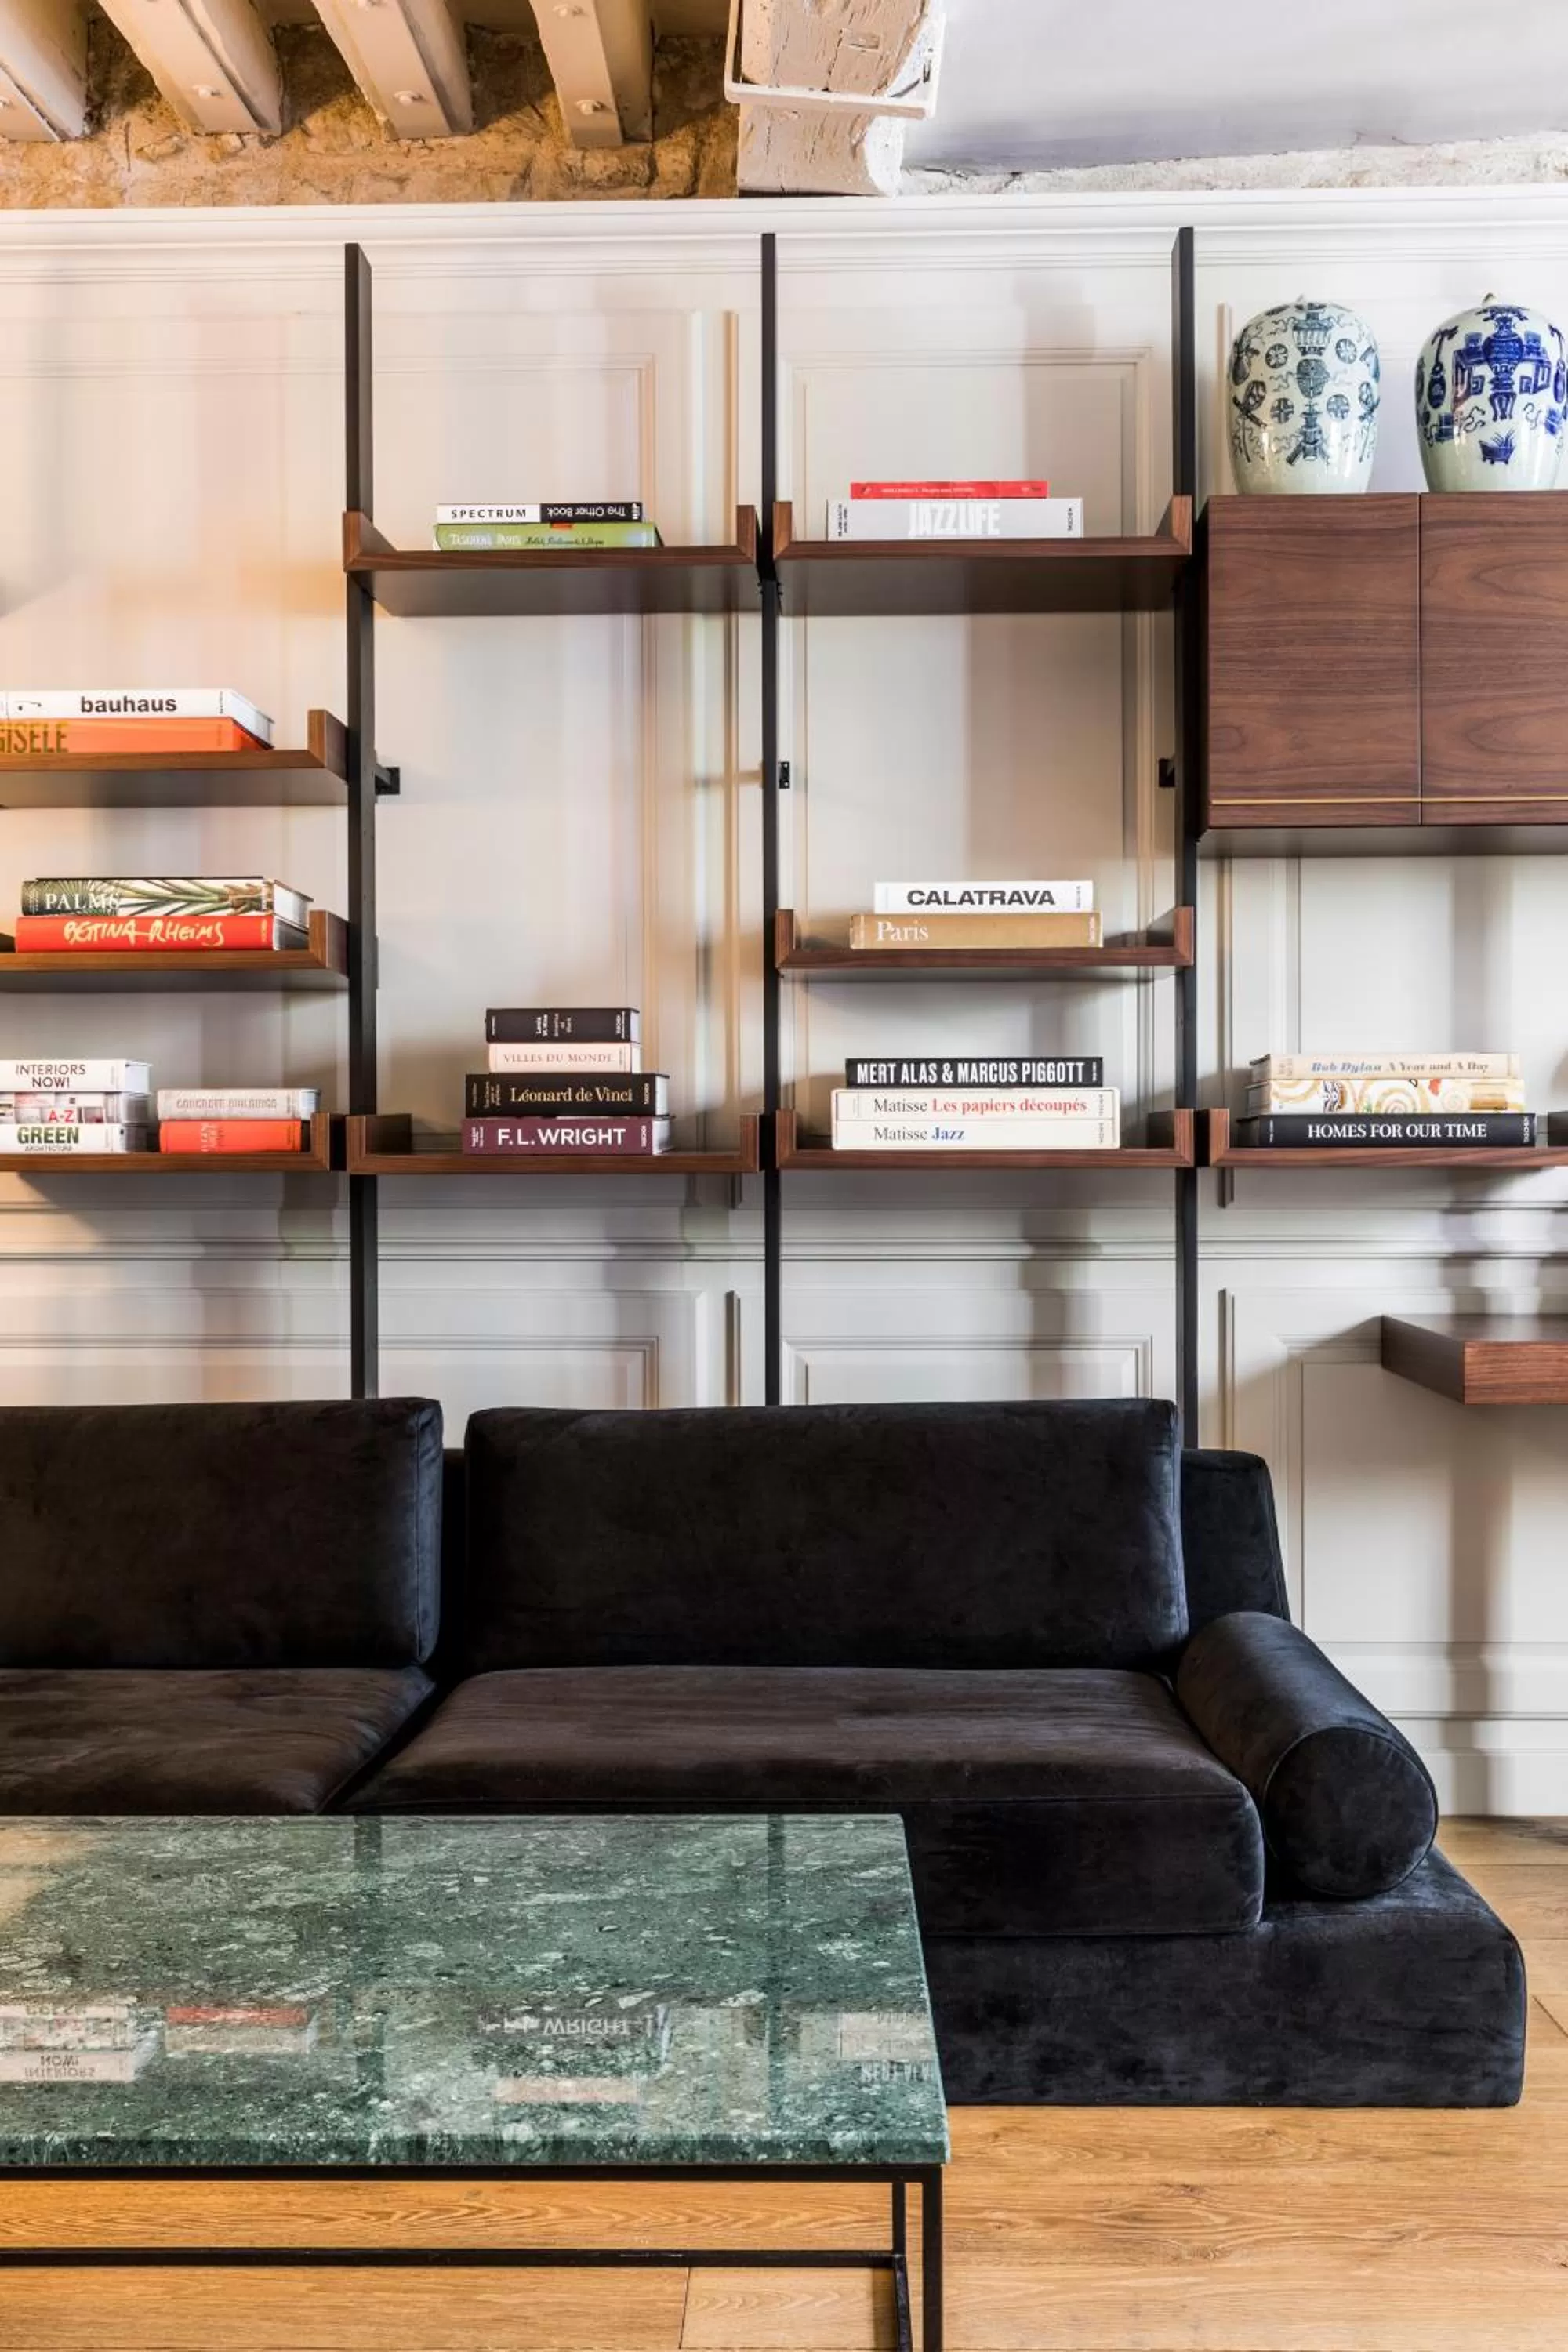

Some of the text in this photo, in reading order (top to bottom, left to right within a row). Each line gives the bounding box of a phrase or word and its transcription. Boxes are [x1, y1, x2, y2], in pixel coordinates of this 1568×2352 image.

[451, 509, 527, 519] SPECTRUM
[547, 506, 626, 517] The Other Book
[909, 502, 1000, 537] JAZZLIFE
[81, 695, 177, 713] bauhaus
[45, 892, 120, 910] PALMS
[907, 890, 1055, 906] CALATRAVA
[64, 920, 136, 945] BETTINA
[877, 920, 929, 942] Paris
[568, 1054, 612, 1062] MONDE
[16, 1064, 85, 1075] INTERIORS
[857, 1062, 897, 1083] MERT
[902, 1062, 938, 1083] ALAS
[942, 1062, 953, 1083] &
[957, 1062, 1018, 1083] MARCUS
[1022, 1062, 1084, 1082] PIGGOTT
[1341, 1062, 1381, 1073] Dylan
[1429, 1062, 1451, 1071] and
[32, 1077, 70, 1088] NOW!
[510, 1087, 572, 1102] Léonard
[575, 1087, 593, 1102] de
[595, 1087, 633, 1102] Vinci
[873, 1098, 927, 1112] Matisse
[932, 1098, 957, 1112] Les
[962, 1098, 1015, 1116] papiers
[1020, 1097, 1087, 1116] découpés
[17, 1127, 79, 1144] GREEN
[498, 1128, 514, 1145] F.
[517, 1128, 535, 1145] L.
[538, 1128, 626, 1145] WRIGHT
[873, 1127, 965, 1141] Matisse Jazz
[1307, 1123, 1487, 1138] HOMES FOR OUR TIME
